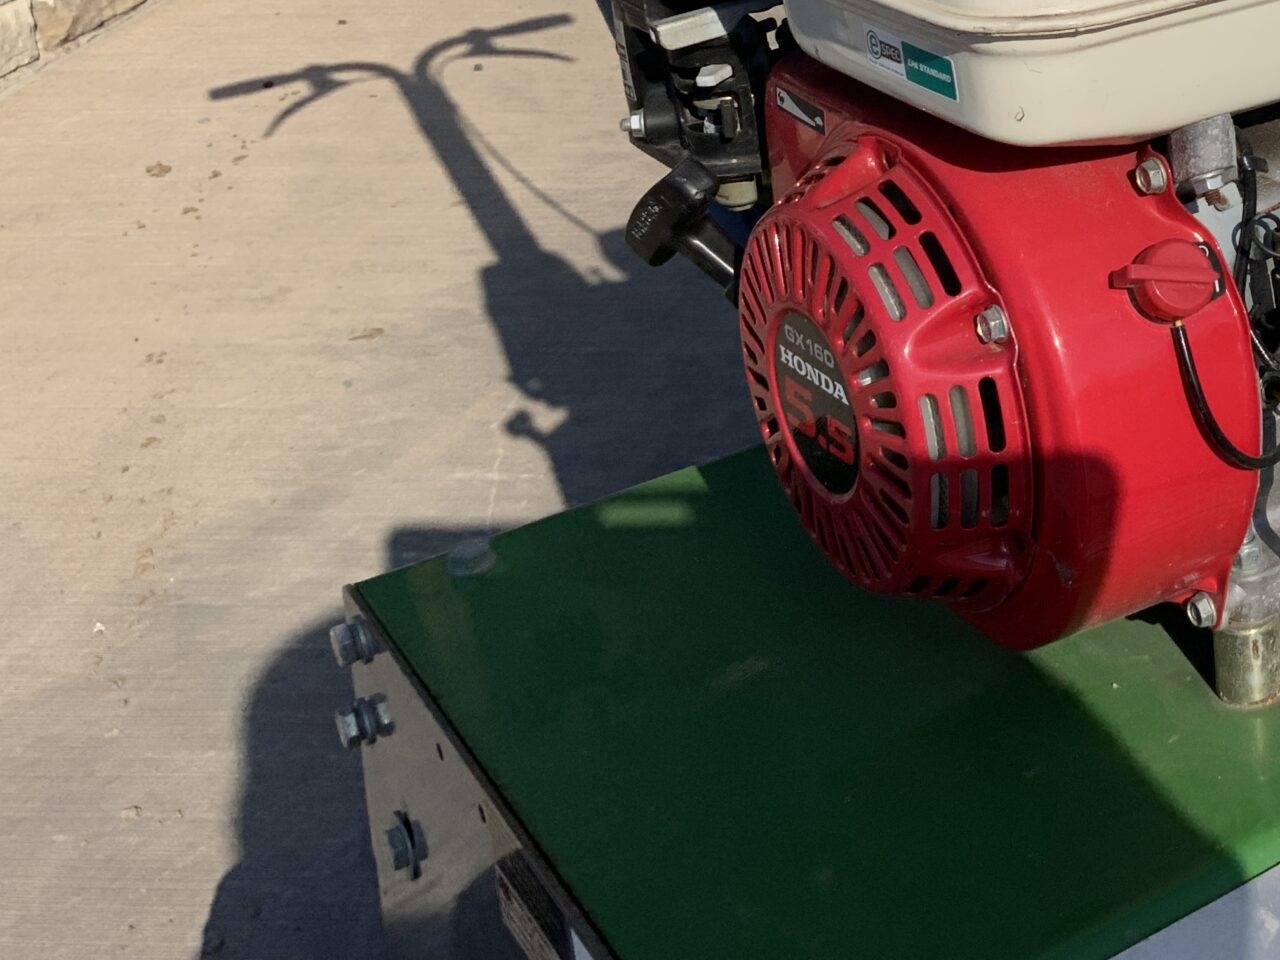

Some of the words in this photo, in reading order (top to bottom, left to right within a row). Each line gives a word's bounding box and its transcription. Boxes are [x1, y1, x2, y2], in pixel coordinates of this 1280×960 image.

[919, 63, 952, 83] STANDARD
[784, 324, 834, 369] GX160
[779, 344, 850, 406] HONDA
[785, 374, 854, 465] 5.5
